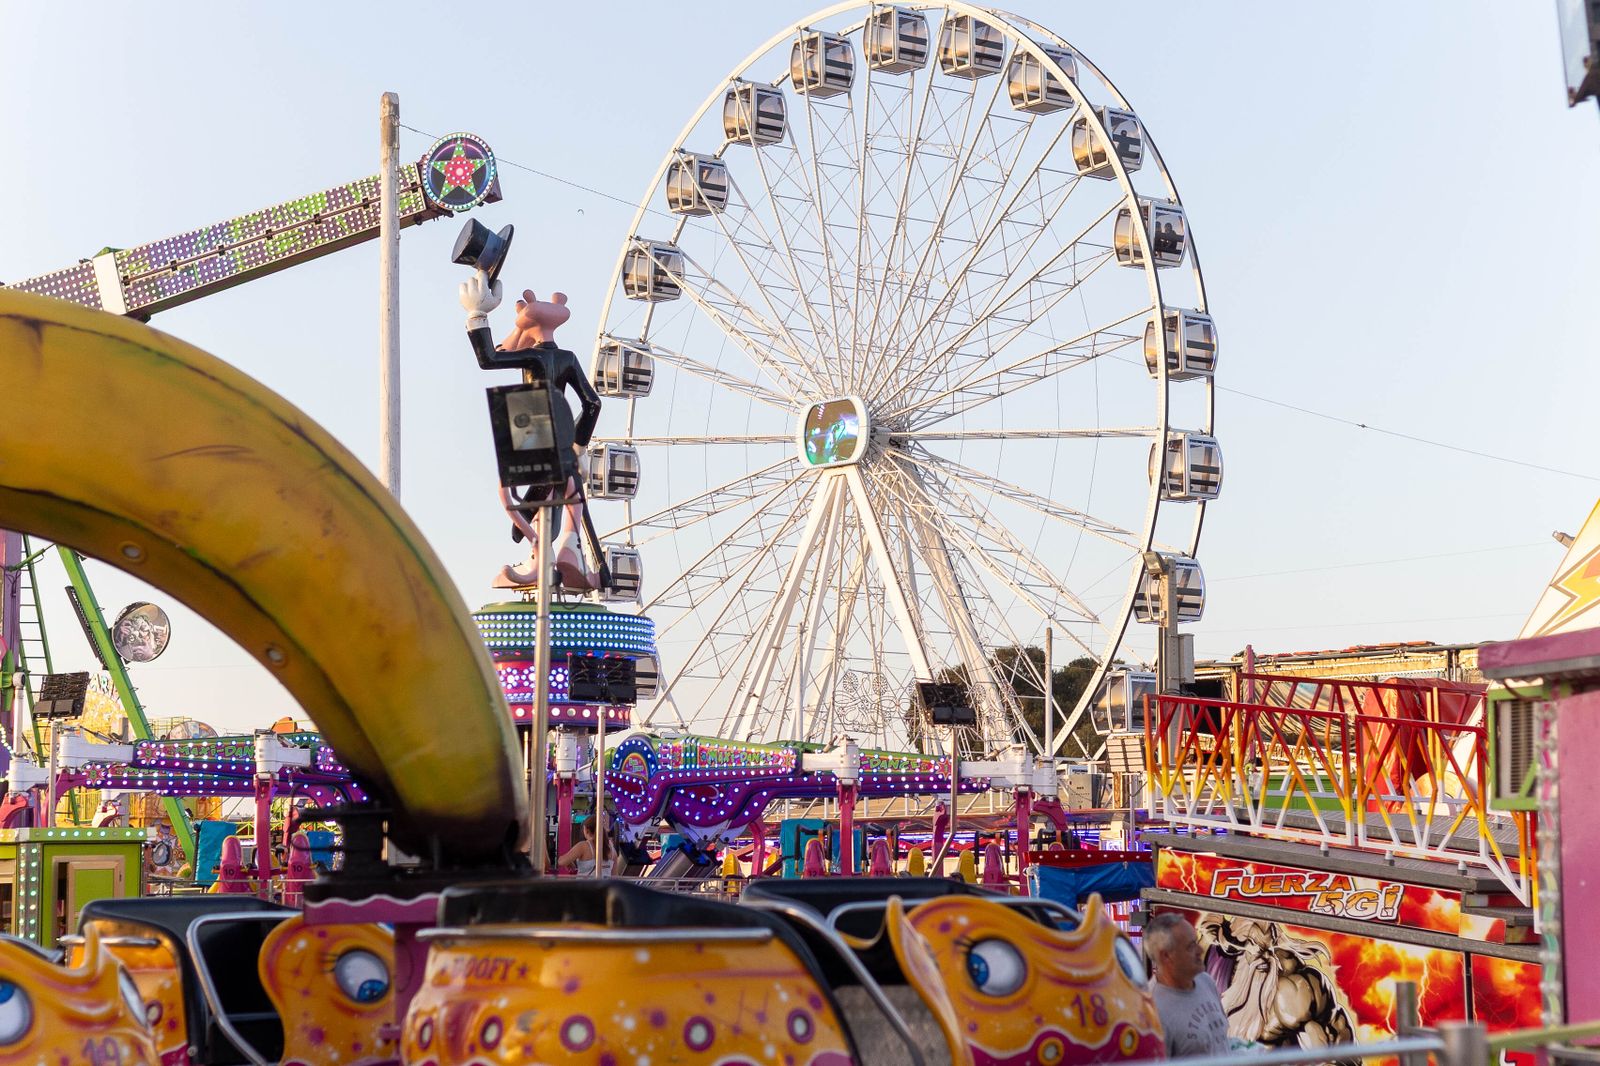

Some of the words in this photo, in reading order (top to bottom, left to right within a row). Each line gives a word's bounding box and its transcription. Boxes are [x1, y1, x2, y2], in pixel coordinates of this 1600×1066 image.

[861, 757, 920, 770] -DANCE
[224, 868, 235, 876] 10
[292, 864, 303, 873] 10
[1211, 868, 1354, 897] FUERZA
[1070, 991, 1109, 1028] 18
